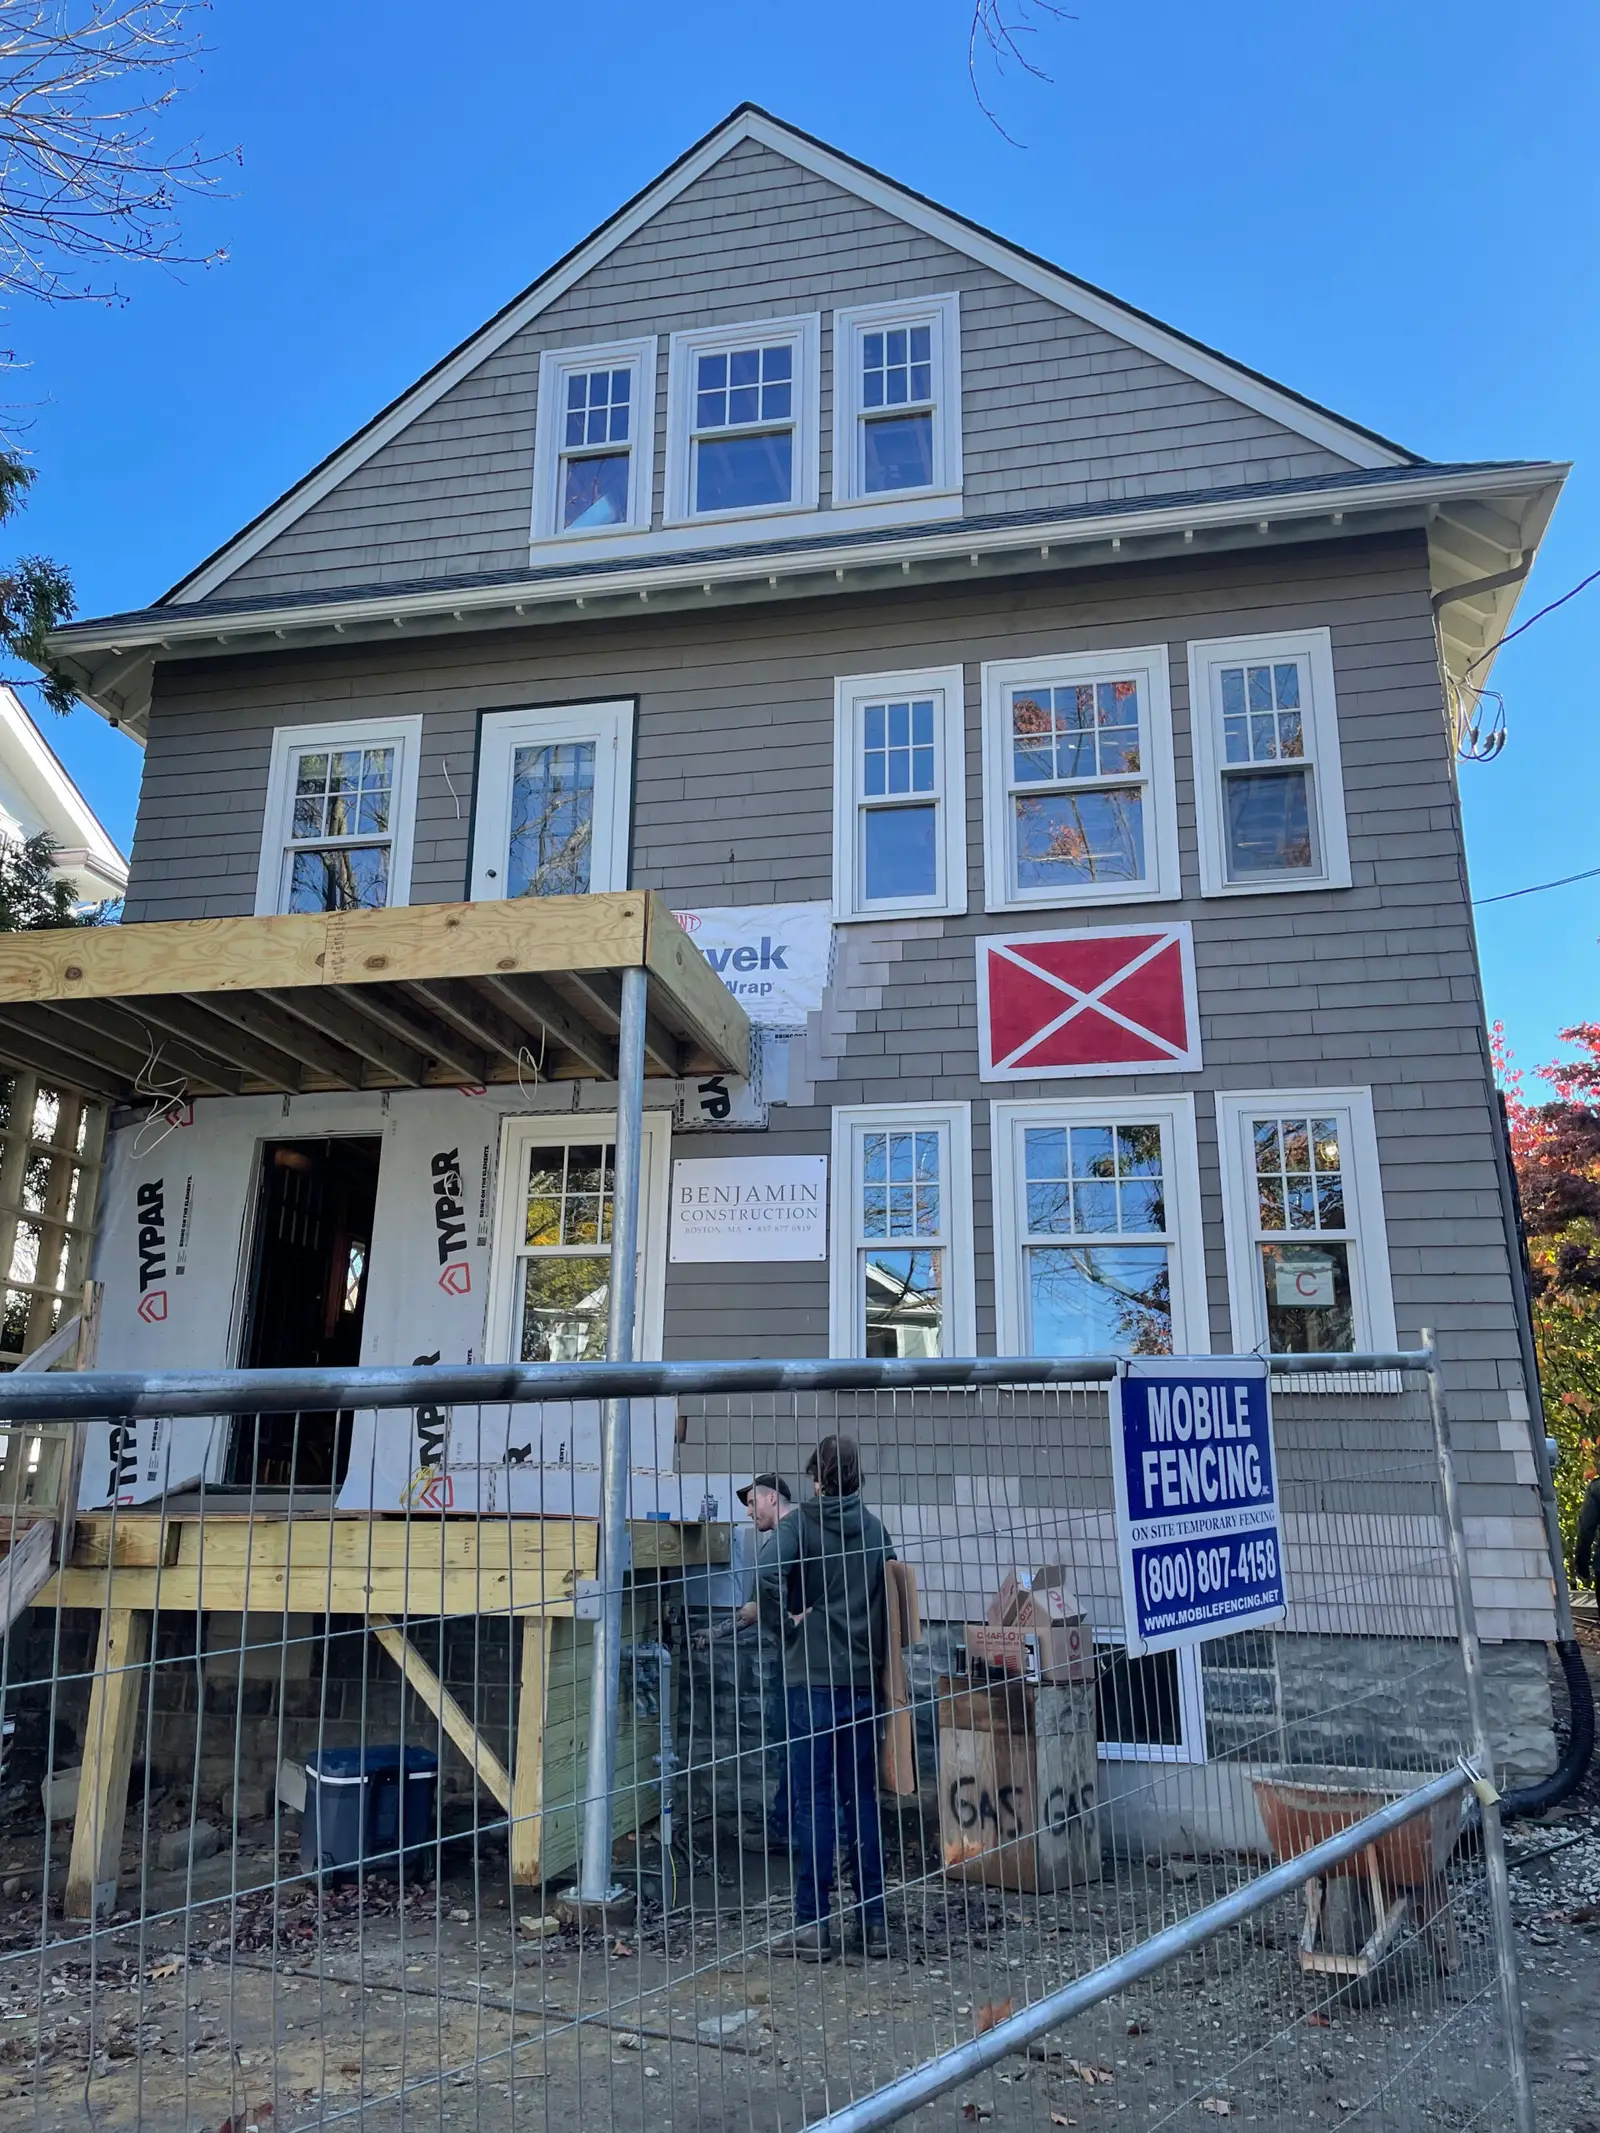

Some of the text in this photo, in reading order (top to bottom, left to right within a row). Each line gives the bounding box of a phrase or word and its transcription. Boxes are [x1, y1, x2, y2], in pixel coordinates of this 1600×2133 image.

[700, 936, 791, 973] vek
[725, 980, 773, 996] Wrap
[431, 1147, 468, 1266] TYPAR
[680, 1183, 819, 1207] BENJAMIN
[680, 1207, 819, 1222] CONSTRUCTION
[137, 1178, 167, 1293] TYPAR
[727, 1226, 742, 1234] MA
[1295, 1271, 1318, 1297] C
[1146, 1385, 1251, 1443] MOBILE
[107, 1420, 138, 1498] TYP
[1141, 1443, 1262, 1509] FENCING
[1132, 1509, 1275, 1542] ON SITE TEMPORARY FENCING
[1141, 1538, 1277, 1611] (800) 807-4158
[1144, 1589, 1280, 1632] WWW.MOBILEFENCING.NET
[949, 1775, 1024, 1839] GAS
[1043, 1783, 1096, 1838] GAS
